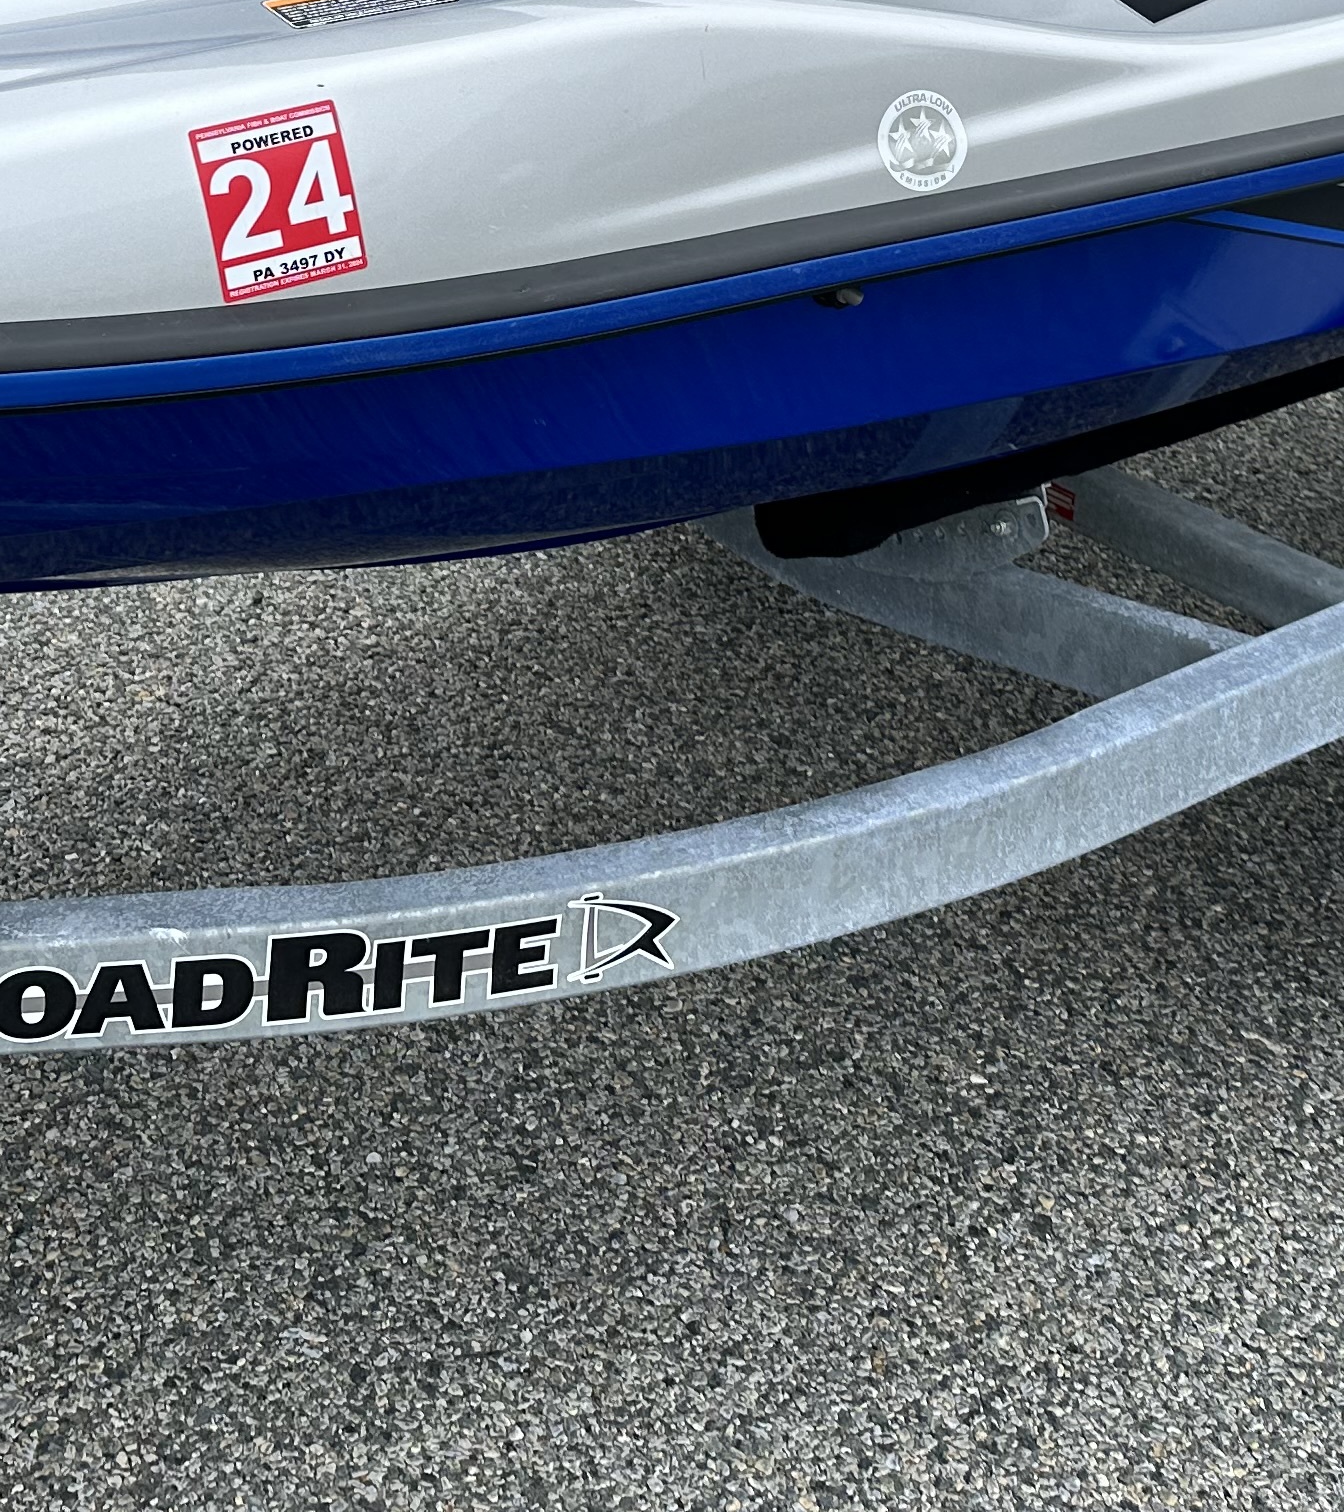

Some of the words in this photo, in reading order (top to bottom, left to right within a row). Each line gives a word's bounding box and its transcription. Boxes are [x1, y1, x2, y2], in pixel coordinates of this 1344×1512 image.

[894, 93, 927, 112] ULTRA
[930, 95, 953, 115] LOW
[196, 123, 245, 139] PENNSYLVANIA
[247, 120, 263, 130] FISH
[270, 114, 287, 123] BOAT
[289, 105, 330, 119] COMMISSION
[231, 125, 314, 154] POWERED
[900, 173, 946, 187] EMISSION
[209, 138, 355, 262] 24
[253, 267, 275, 282] PA
[280, 254, 318, 275] 3497
[324, 247, 346, 263] DY
[230, 280, 279, 297] REGISTRATION
[310, 266, 336, 277] MARCH
